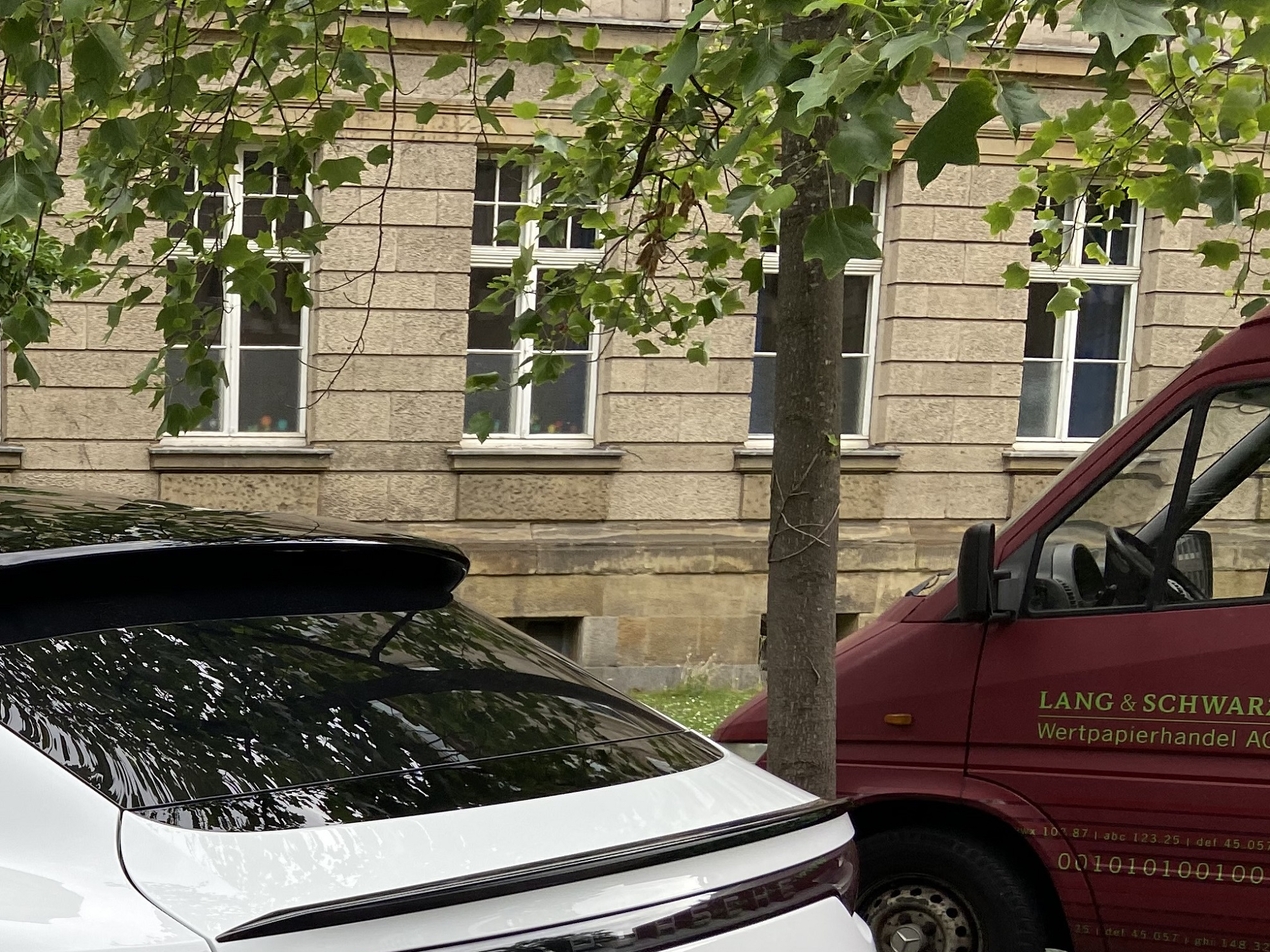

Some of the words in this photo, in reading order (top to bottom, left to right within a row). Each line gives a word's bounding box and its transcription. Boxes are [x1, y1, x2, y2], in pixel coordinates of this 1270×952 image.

[1038, 690, 1115, 711] LANG
[1120, 693, 1137, 712] &
[1037, 722, 1236, 748] Wertpapierhandel
[1103, 831, 1126, 842] abc
[1196, 837, 1218, 847] def
